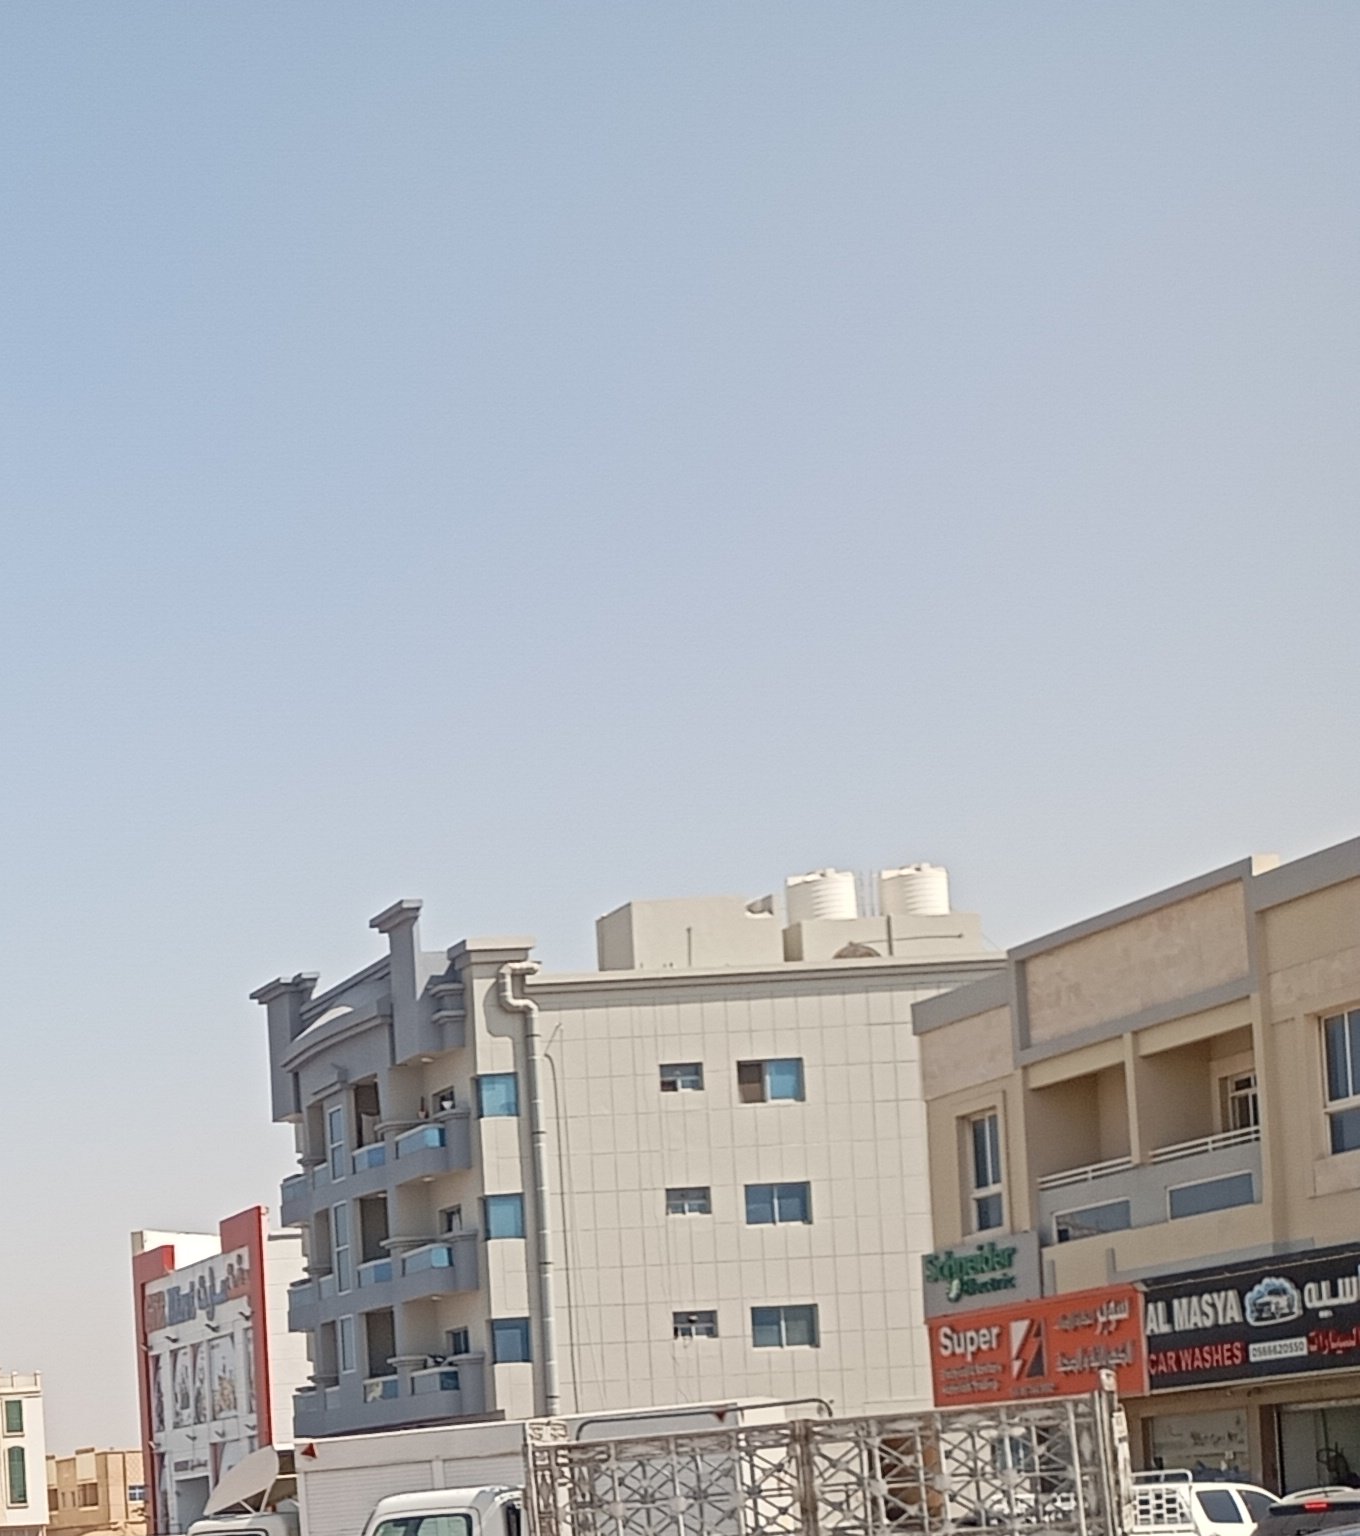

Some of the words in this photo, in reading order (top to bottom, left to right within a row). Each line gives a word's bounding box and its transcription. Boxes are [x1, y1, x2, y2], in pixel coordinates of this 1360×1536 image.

[1146, 1300, 1173, 1336] AL
[1173, 1289, 1244, 1331] MASYA
[939, 1326, 999, 1362] Super
[1148, 1349, 1178, 1375] CAR
[1180, 1341, 1243, 1371] WASHES
